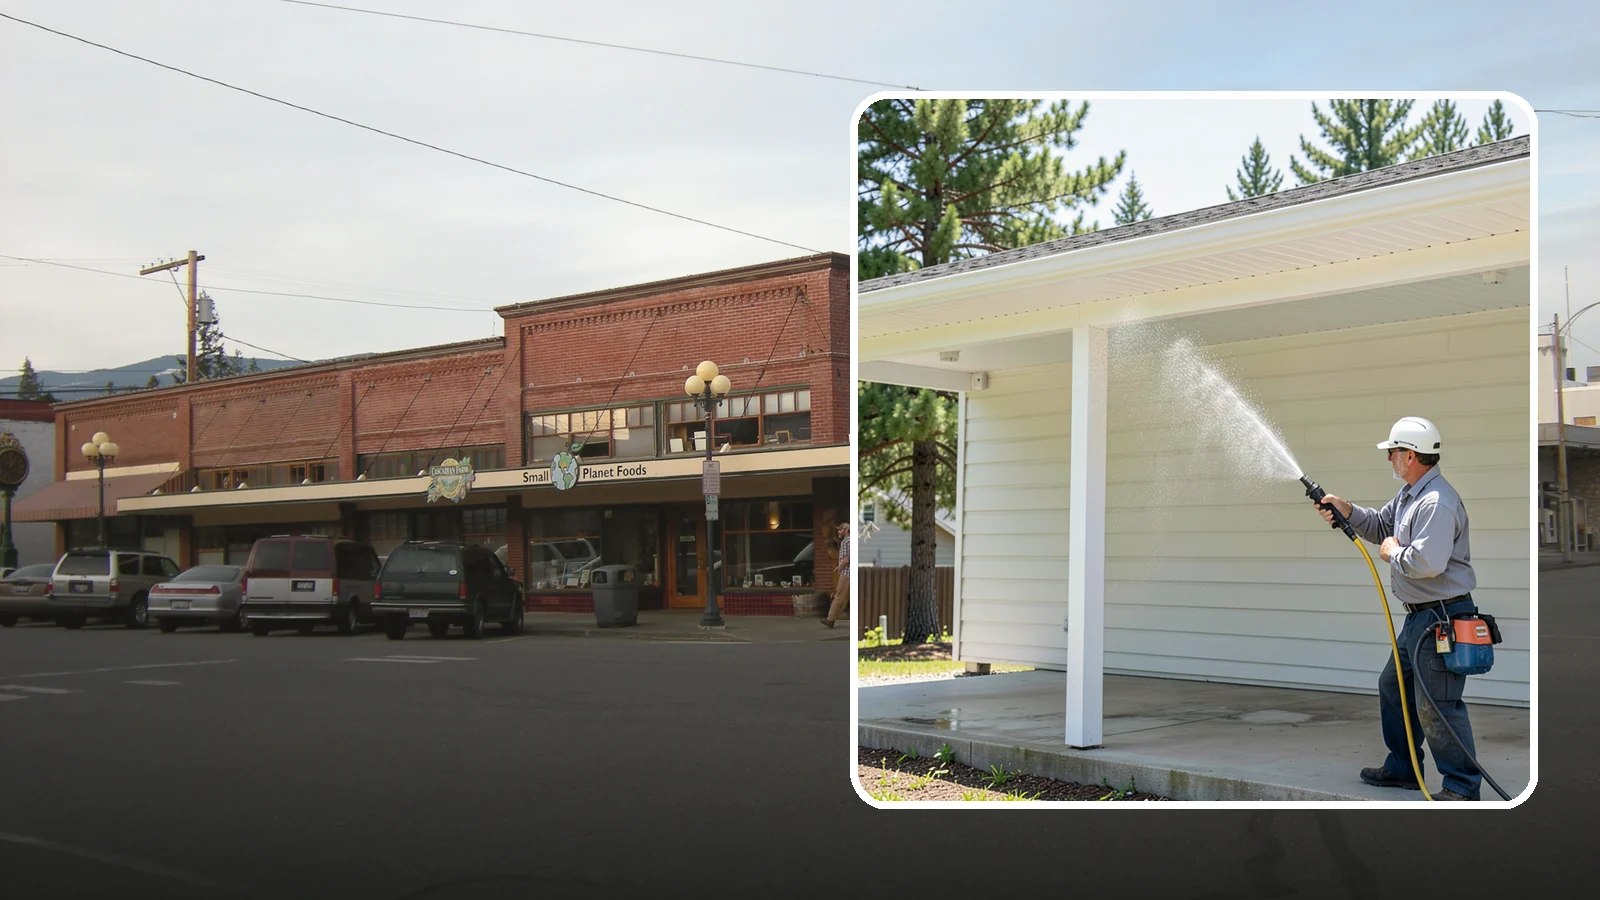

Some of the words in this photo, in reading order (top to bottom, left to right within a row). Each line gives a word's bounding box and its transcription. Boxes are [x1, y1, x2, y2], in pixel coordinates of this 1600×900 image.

[523, 470, 549, 482] Small
[583, 468, 614, 479] Planet
[617, 464, 647, 477] Foods
